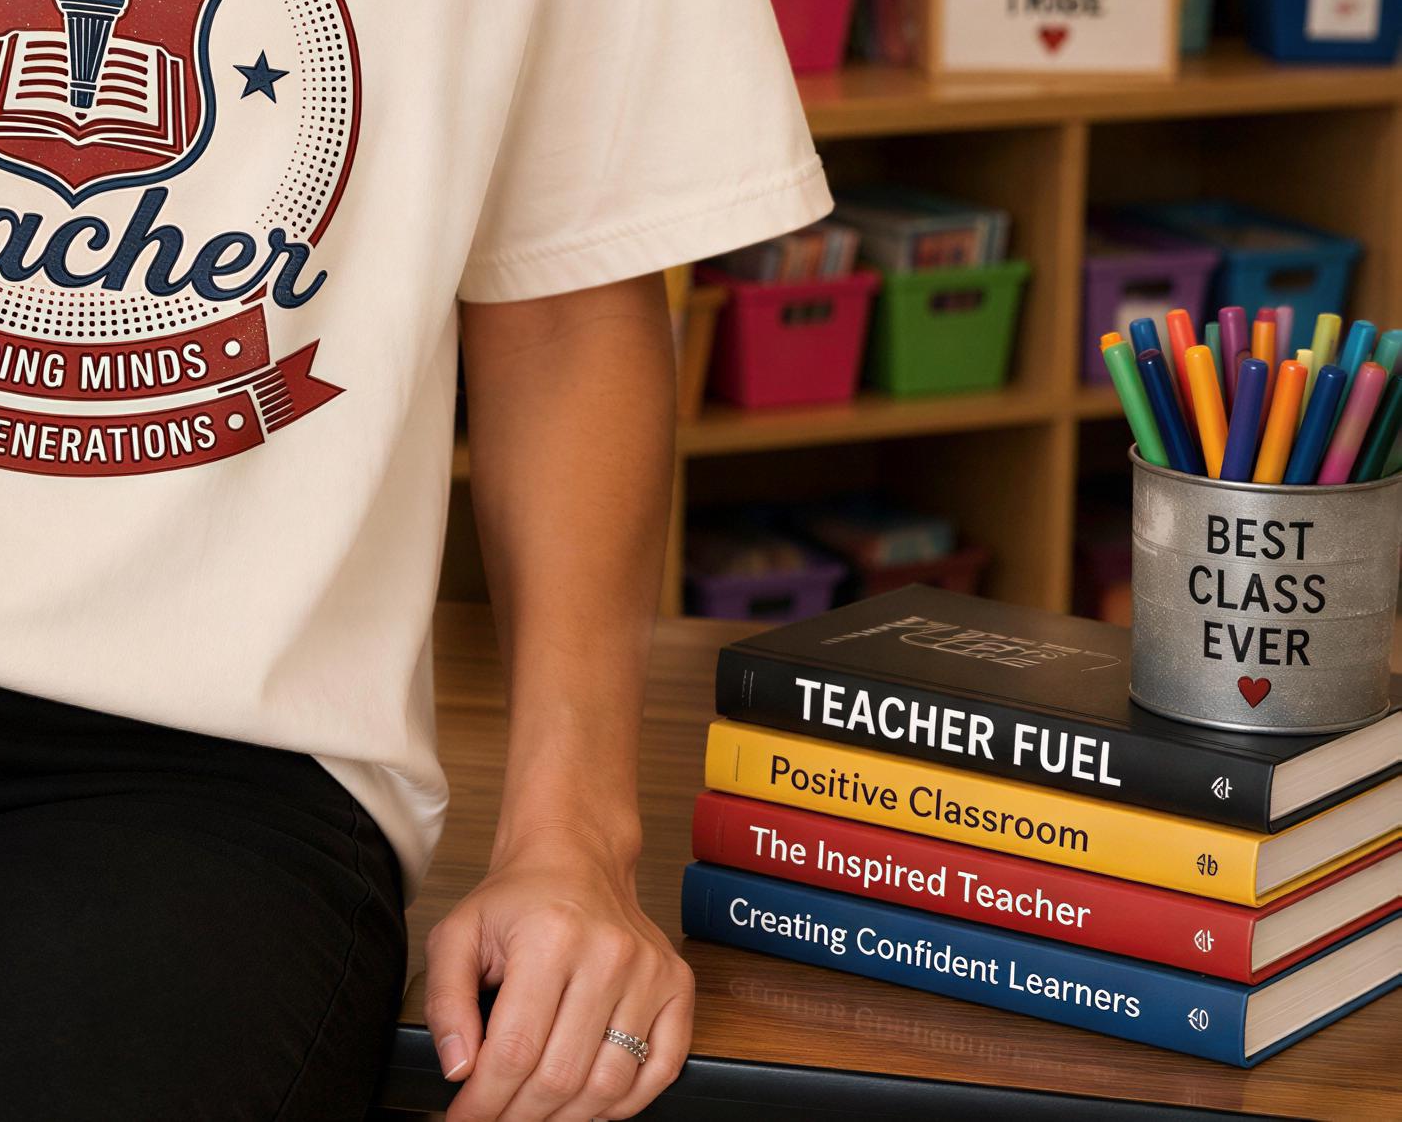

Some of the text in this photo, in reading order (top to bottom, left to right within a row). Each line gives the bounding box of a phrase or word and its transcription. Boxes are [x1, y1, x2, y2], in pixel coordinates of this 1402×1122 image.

[79, 342, 209, 390] MINDS
[1206, 513, 1314, 560] BEST
[1187, 564, 1326, 614] CLASS
[1202, 620, 1311, 666] EVER
[794, 677, 1122, 787] TEACHER FUEL
[769, 754, 1089, 853] Positive Classroom
[748, 825, 1091, 930] The Inspired Teacher
[728, 898, 1141, 1019] Creating Confident Learners
